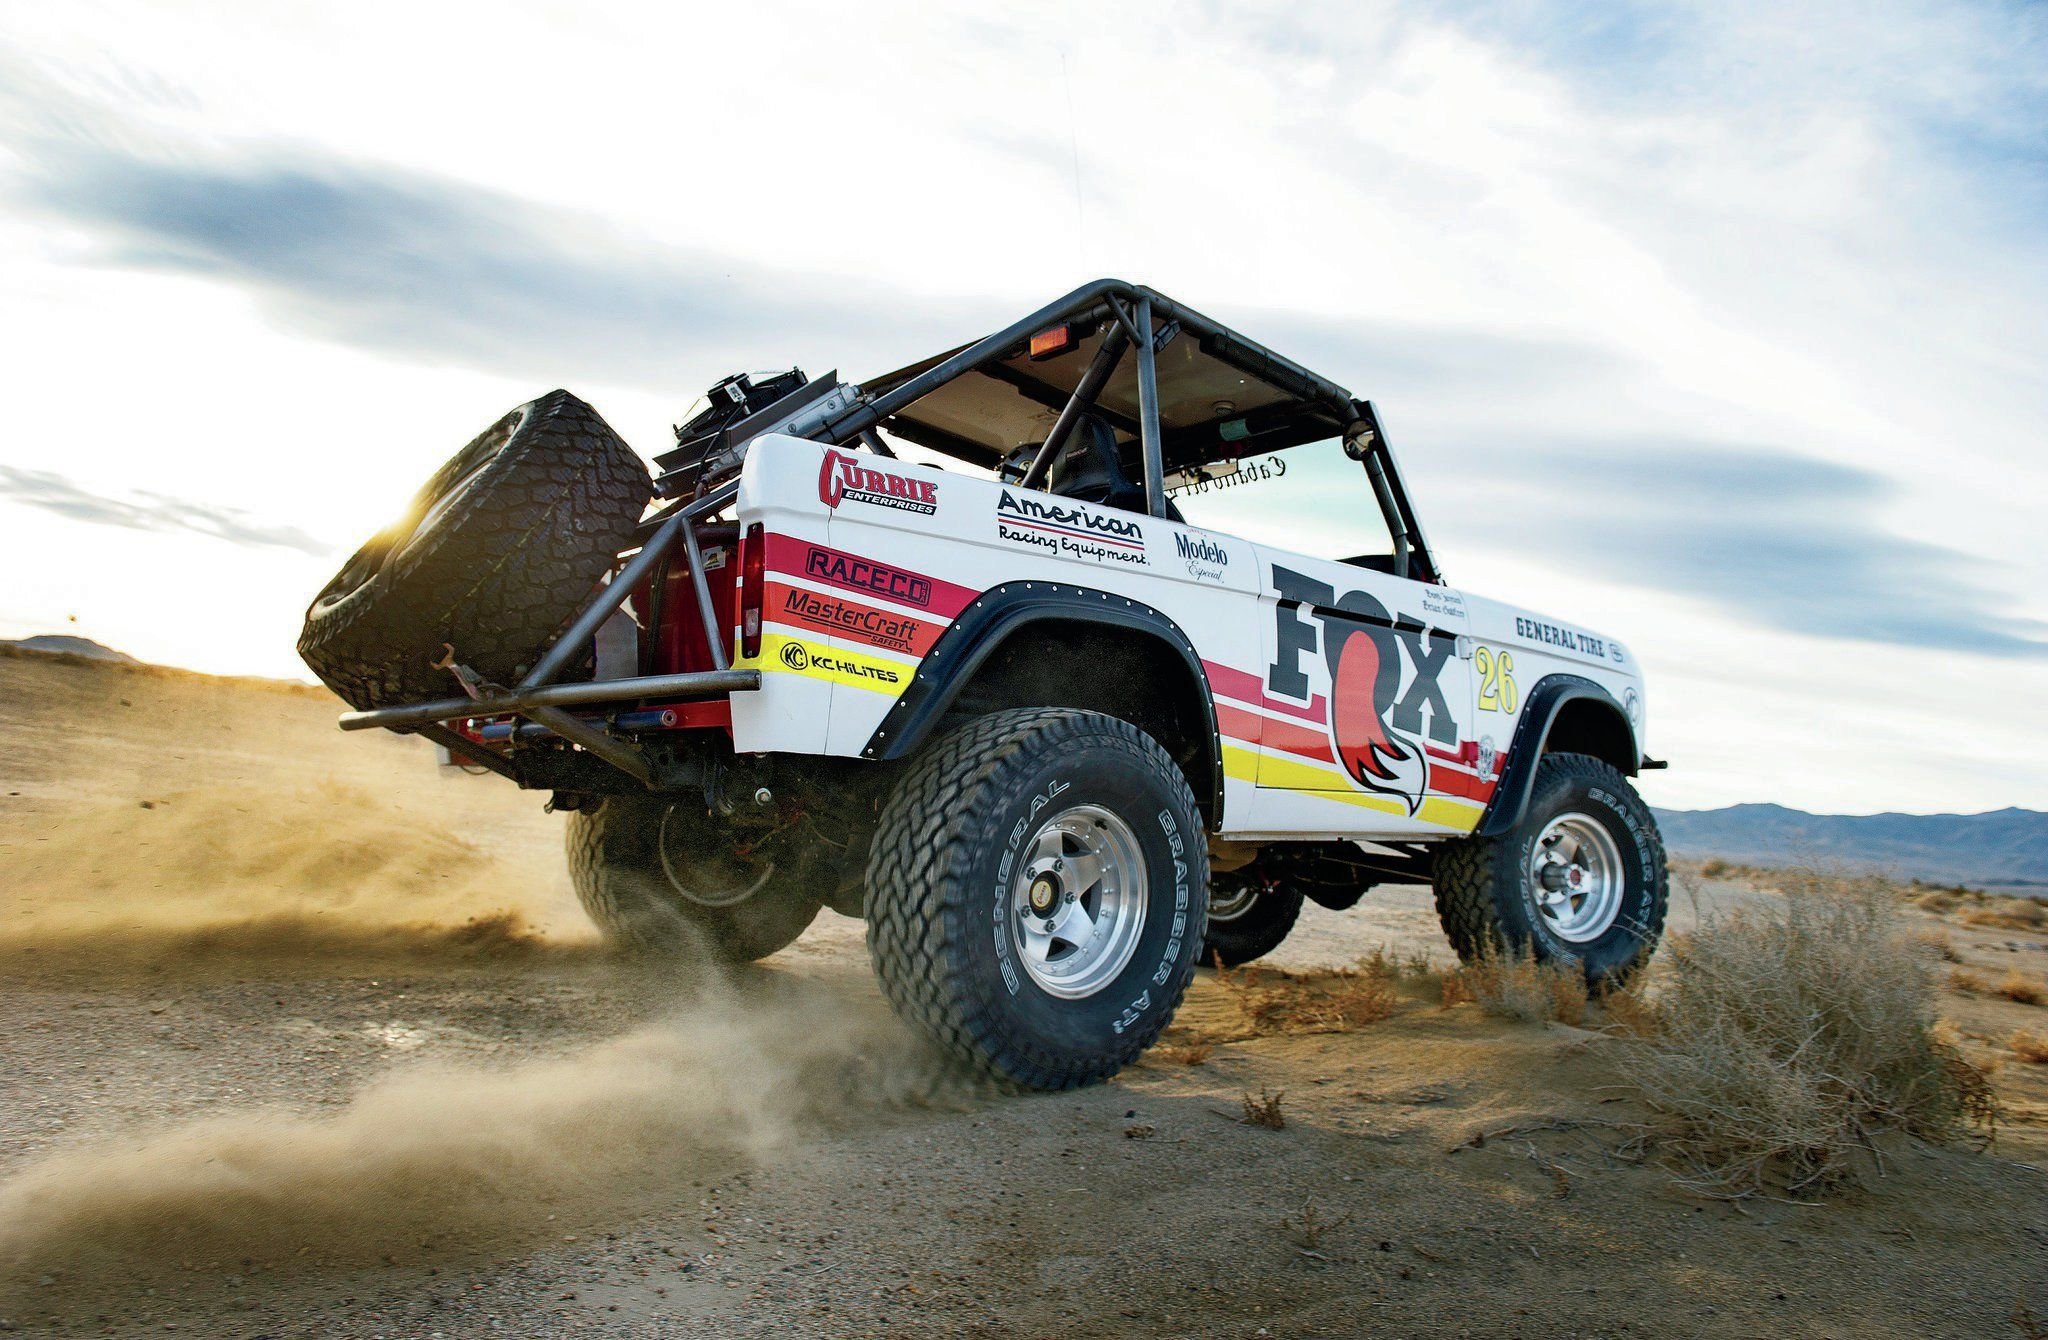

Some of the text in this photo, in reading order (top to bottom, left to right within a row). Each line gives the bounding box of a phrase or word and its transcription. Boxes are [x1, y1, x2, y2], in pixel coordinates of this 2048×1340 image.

[819, 449, 938, 508] CURRIE
[845, 491, 934, 514] ENTERPRISES
[998, 489, 1143, 539] American
[999, 525, 1057, 554] Racing
[1174, 532, 1228, 566] Modelo
[809, 551, 925, 602] RACECO
[785, 590, 918, 640] MasterCraft
[1516, 617, 1605, 658] GENERAL TIRE
[784, 646, 805, 667] KC
[811, 655, 835, 670] KC
[871, 635, 905, 649] SAFETY
[1269, 563, 1457, 747] FOX
[1475, 646, 1518, 715] 26
[993, 780, 1070, 996] GENERAL
[1157, 808, 1189, 987] GRABBER
